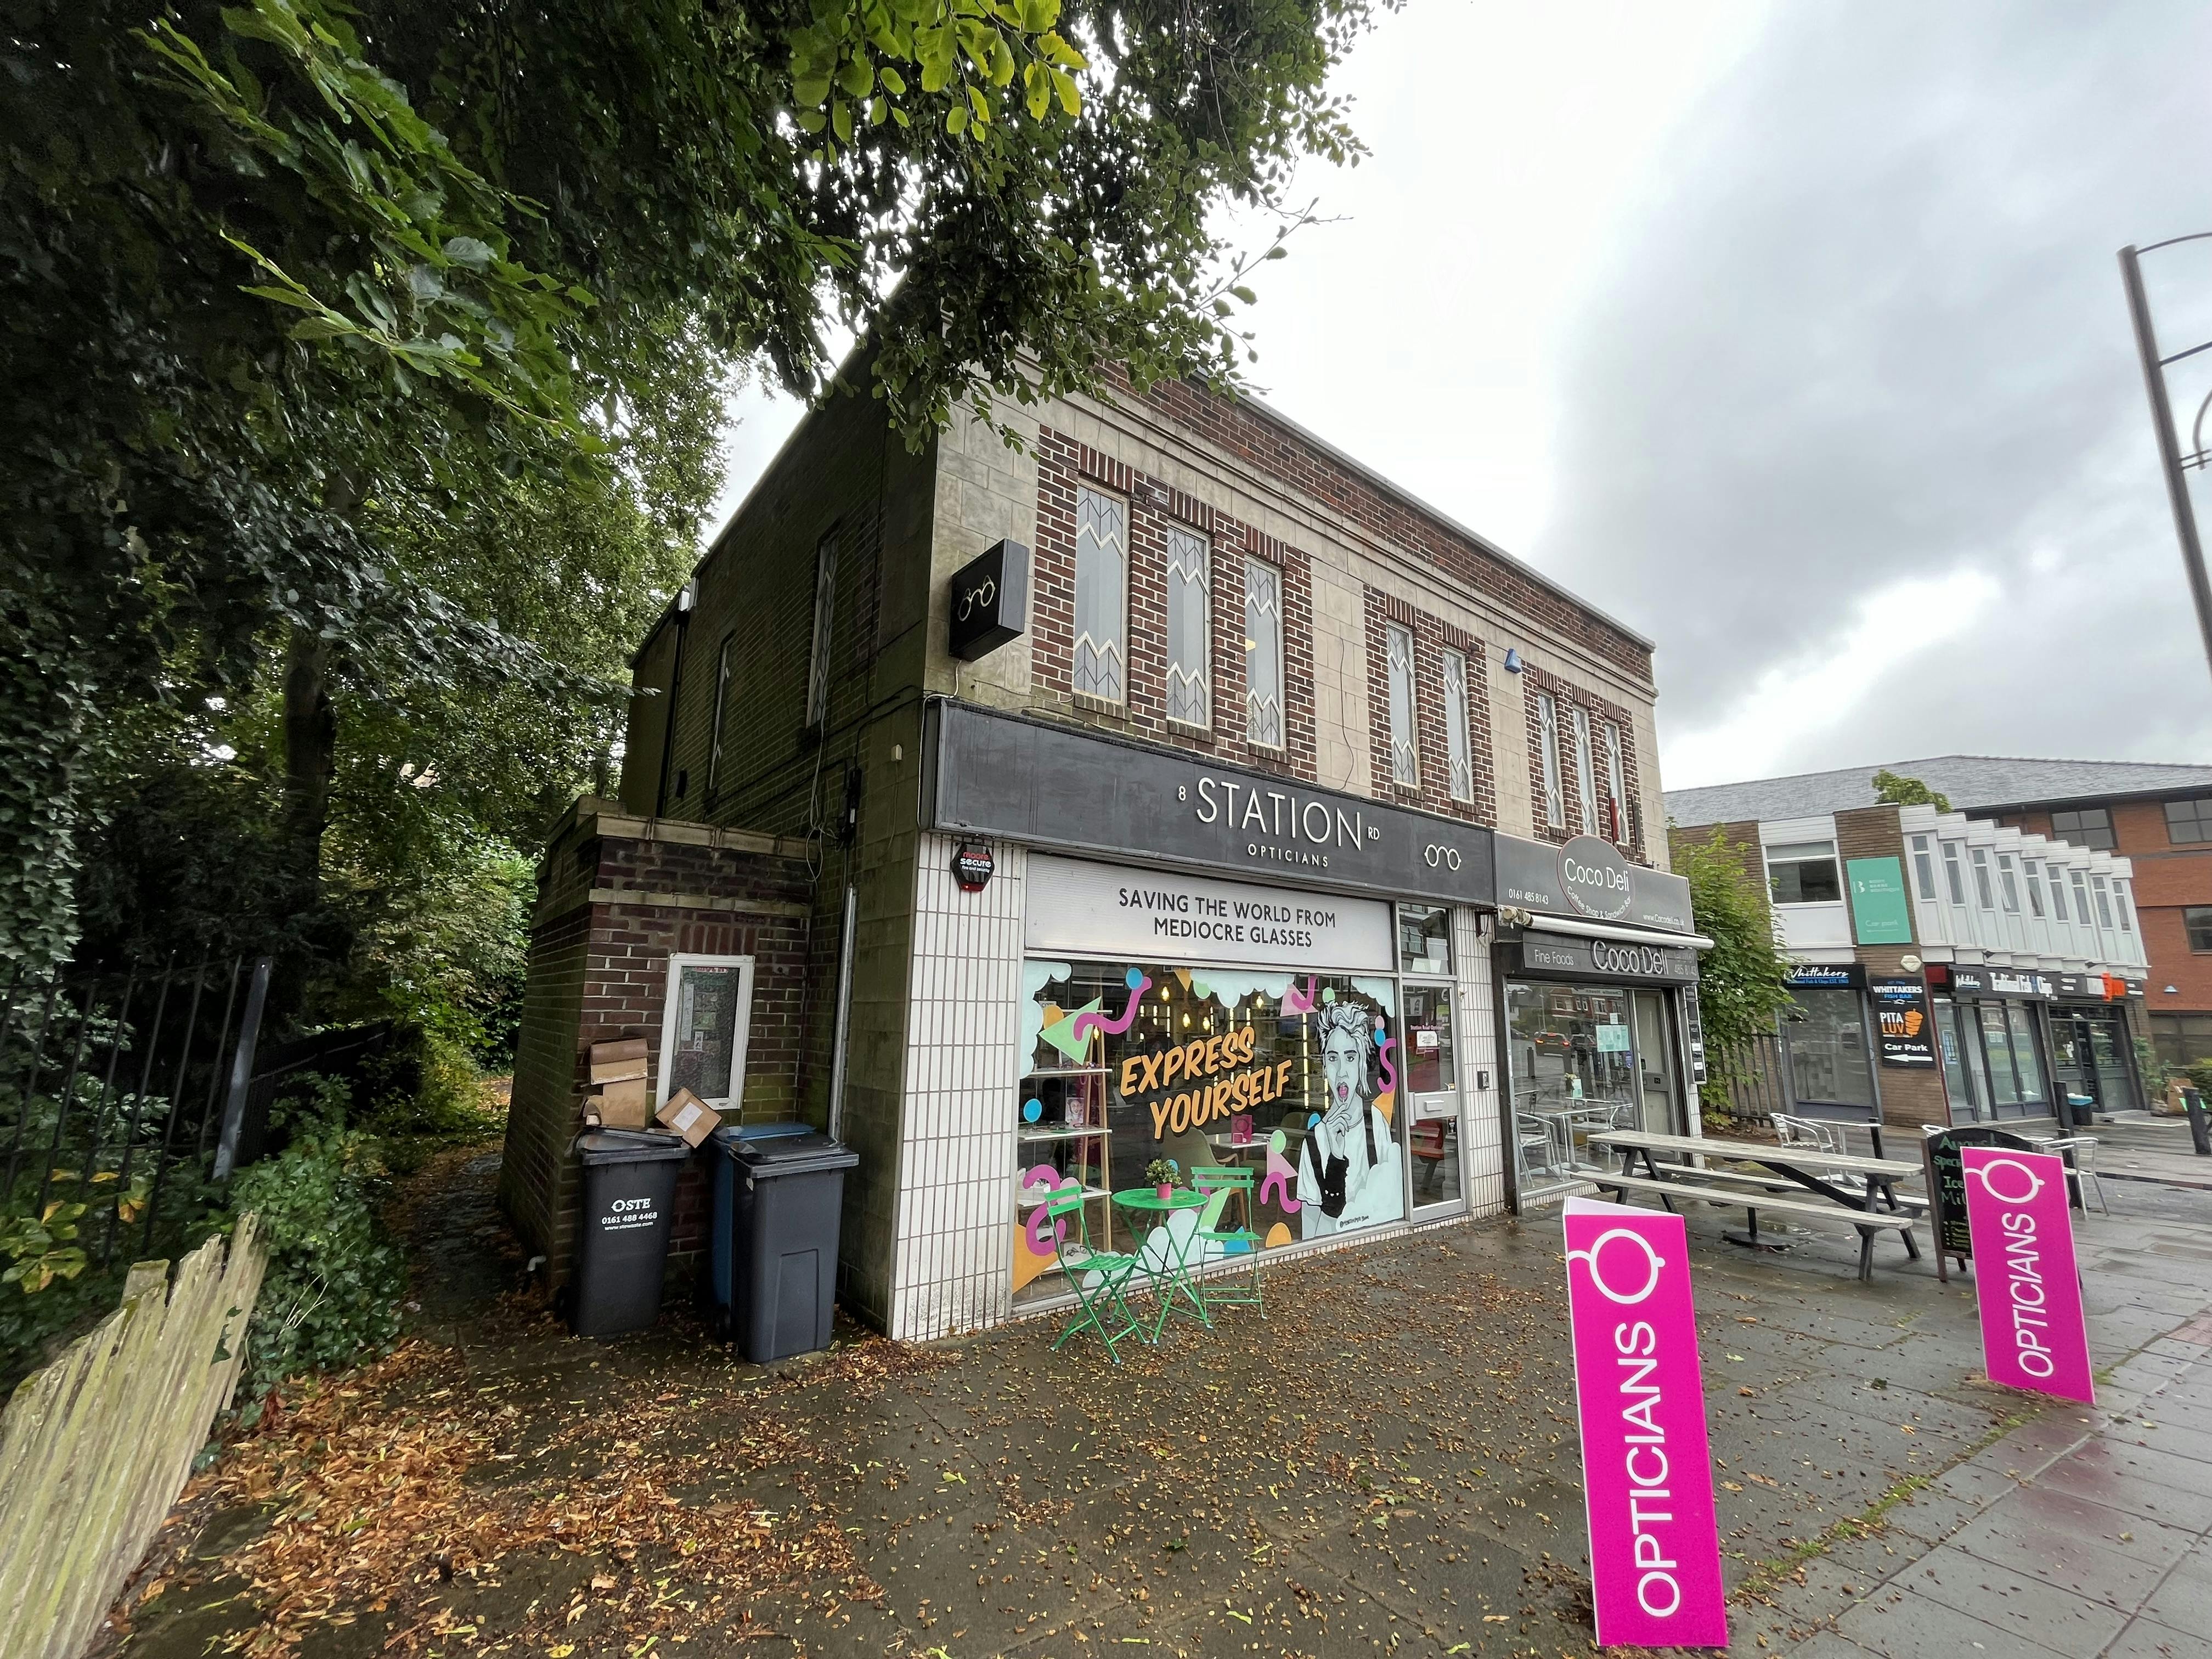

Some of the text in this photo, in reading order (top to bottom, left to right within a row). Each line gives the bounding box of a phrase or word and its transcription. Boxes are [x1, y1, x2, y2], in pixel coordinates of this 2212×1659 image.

[1178, 777, 1380, 851] 8 STATION RD
[960, 857, 992, 868] secure
[963, 851, 989, 860] moore
[1248, 843, 1329, 867] OPTICIANS
[1564, 857, 1630, 892] Coco Deli
[1119, 888, 1336, 928] SAVING THE WORLD FROM
[1509, 888, 1549, 905] 0161 485 8143
[1567, 885, 1585, 910] Coffee
[1585, 905, 1599, 917] Shop
[1604, 905, 1626, 919] Sandwich
[1154, 917, 1312, 948] MEDIOCRE GLASSES
[1534, 949, 1575, 966] Fine Foods
[1592, 940, 1669, 975] Coco Deli
[1880, 1012, 1904, 1023] PITA
[1881, 1023, 1904, 1034] LUV
[1120, 1025, 1255, 1097] EXPRESS
[1149, 1059, 1293, 1140] YOURSELF
[601, 1211, 658, 1224] 0161 488 4468
[2001, 1212, 2055, 1378] OPTICIANS
[1614, 1321, 1681, 1618] OPTICIANS
